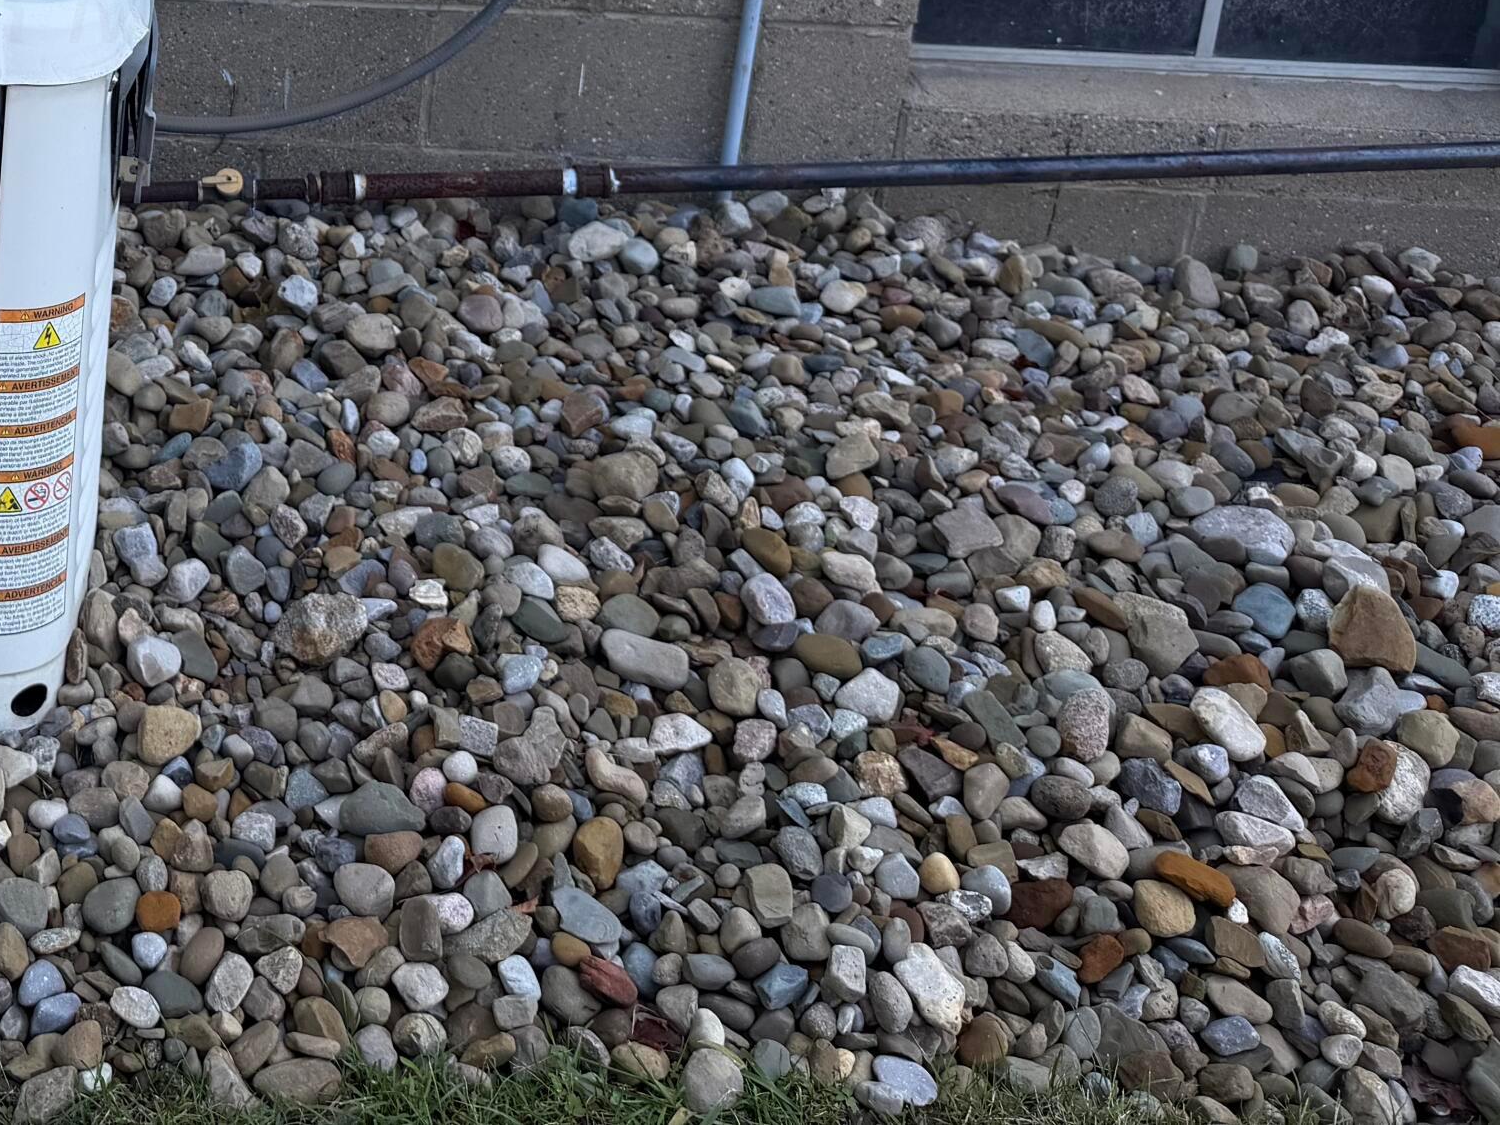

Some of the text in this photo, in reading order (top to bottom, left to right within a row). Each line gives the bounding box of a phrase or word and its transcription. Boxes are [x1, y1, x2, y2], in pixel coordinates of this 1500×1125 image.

[33, 302, 74, 319] WARNING
[11, 366, 79, 391] AVERTISSEMENT
[13, 415, 72, 436] ADVERTENCIA
[23, 463, 62, 480] WARNING
[1, 528, 69, 555] AVERTISSEMENT
[4, 577, 63, 600] ADVERTENCIA
